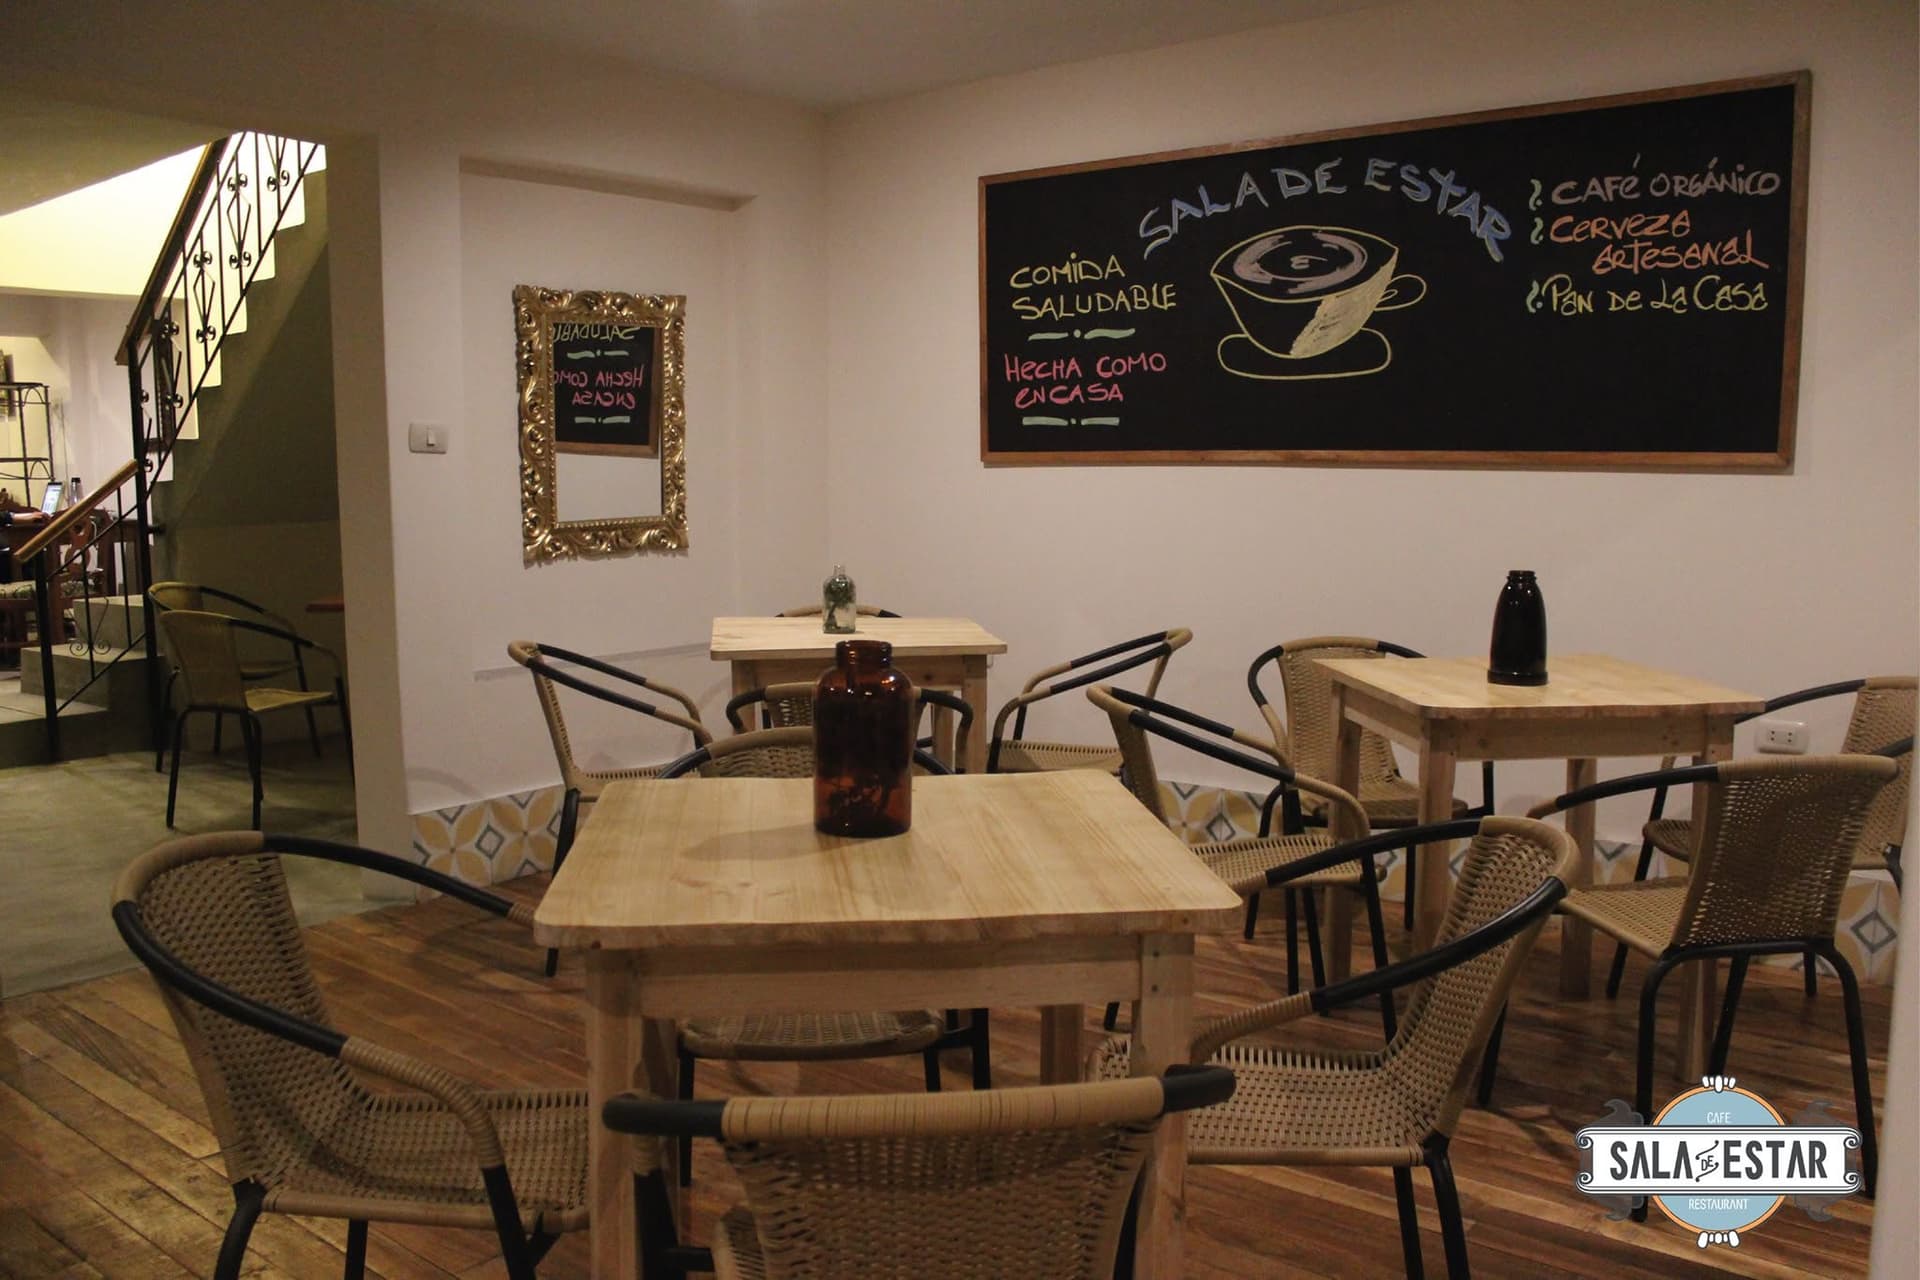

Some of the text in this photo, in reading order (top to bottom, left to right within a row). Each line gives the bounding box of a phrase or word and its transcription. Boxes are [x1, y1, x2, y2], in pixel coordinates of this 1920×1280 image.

[1138, 158, 1512, 262] SALA DE ESTAR
[1011, 282, 1177, 321] SALUDABLE
[1096, 352, 1168, 379] COMO
